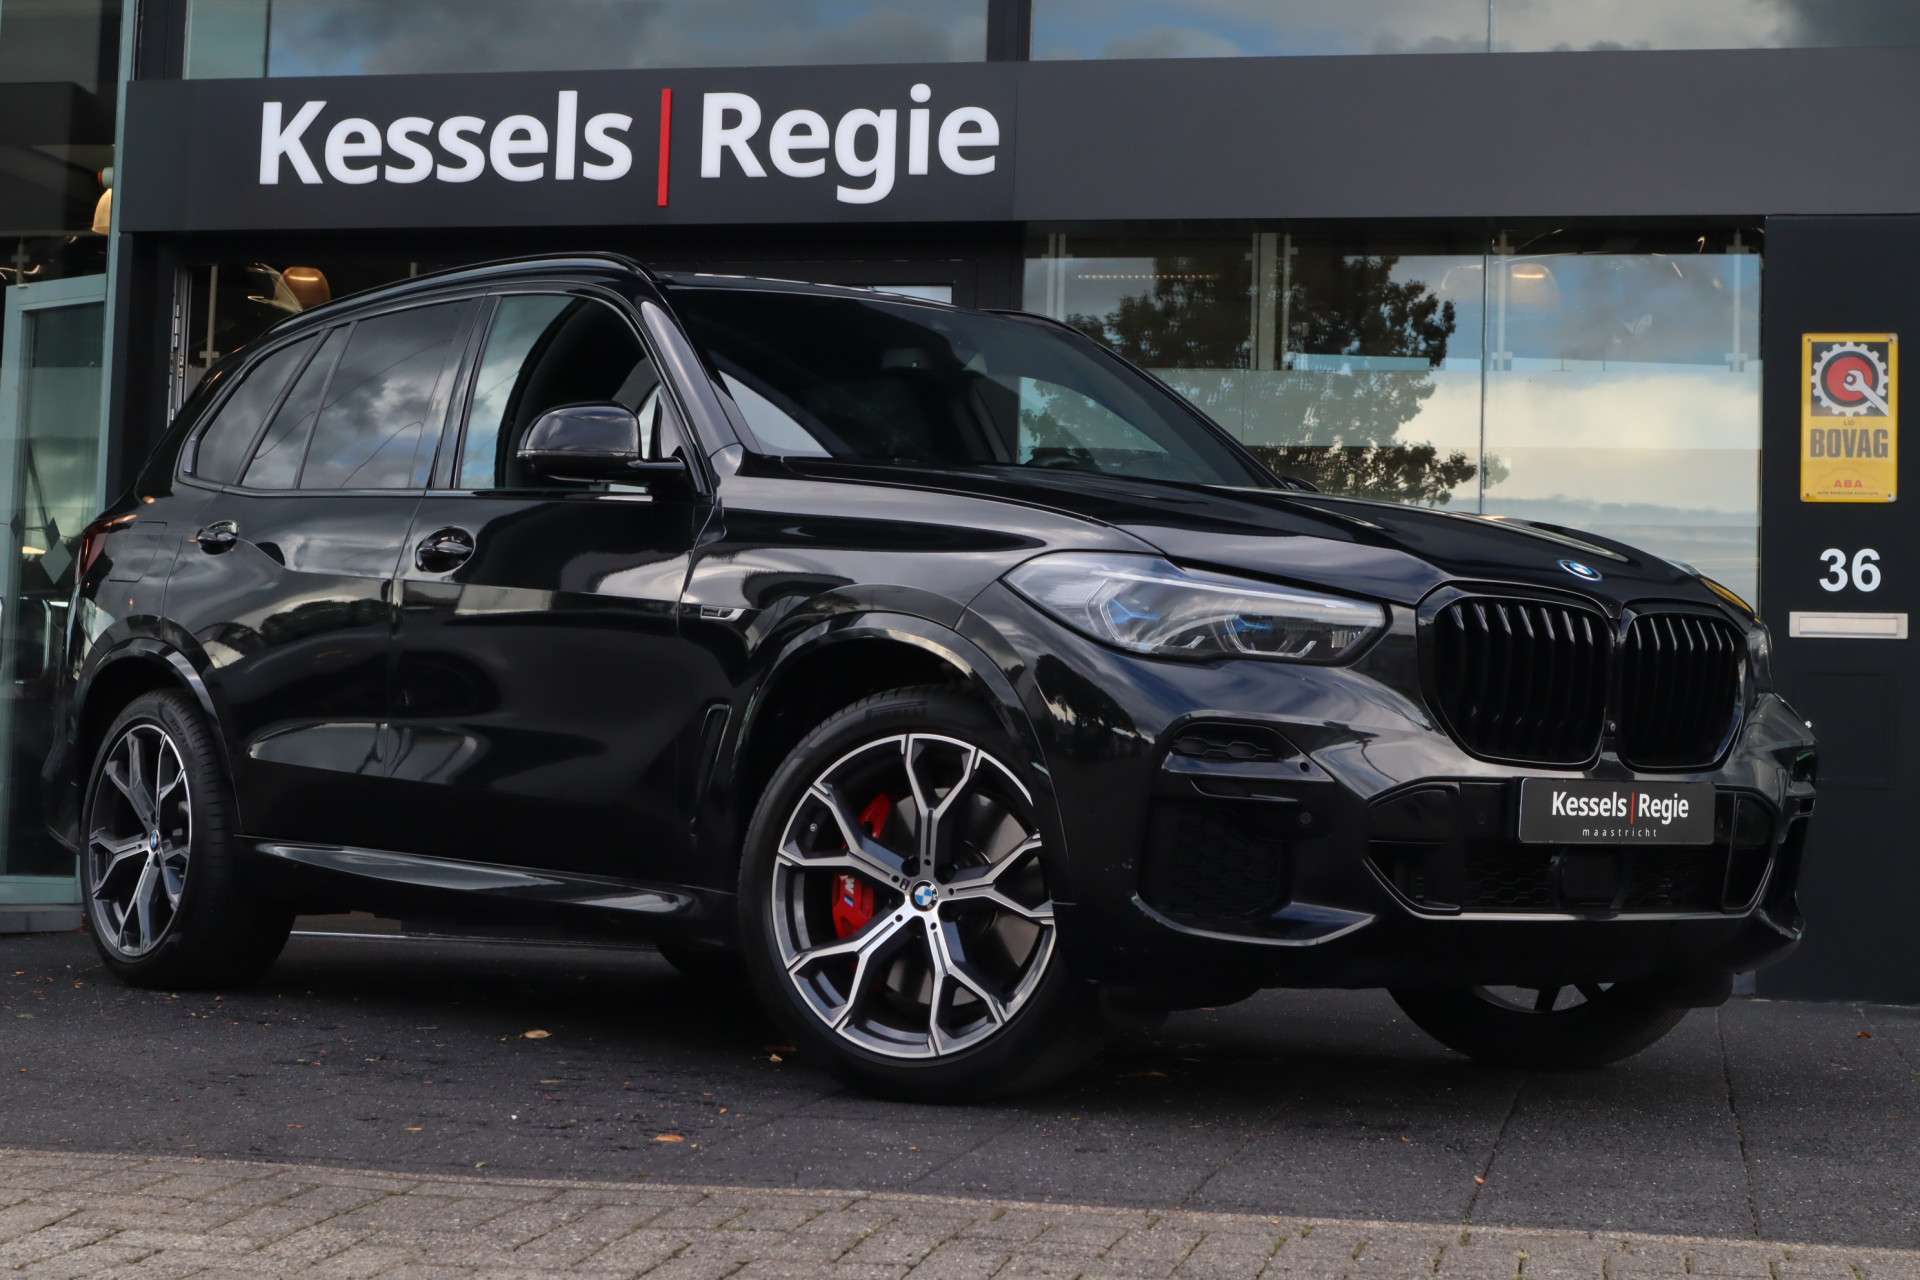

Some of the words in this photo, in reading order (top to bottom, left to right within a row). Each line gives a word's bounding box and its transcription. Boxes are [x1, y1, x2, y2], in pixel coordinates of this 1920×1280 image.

[259, 91, 634, 185] Kessels
[700, 83, 1000, 204] Regie
[1811, 428, 1888, 458] BOVAG
[1819, 548, 1882, 592] 36
[1552, 791, 1627, 817] Kessels
[1638, 793, 1689, 825] Regie
[1582, 827, 1657, 838] maastricht
